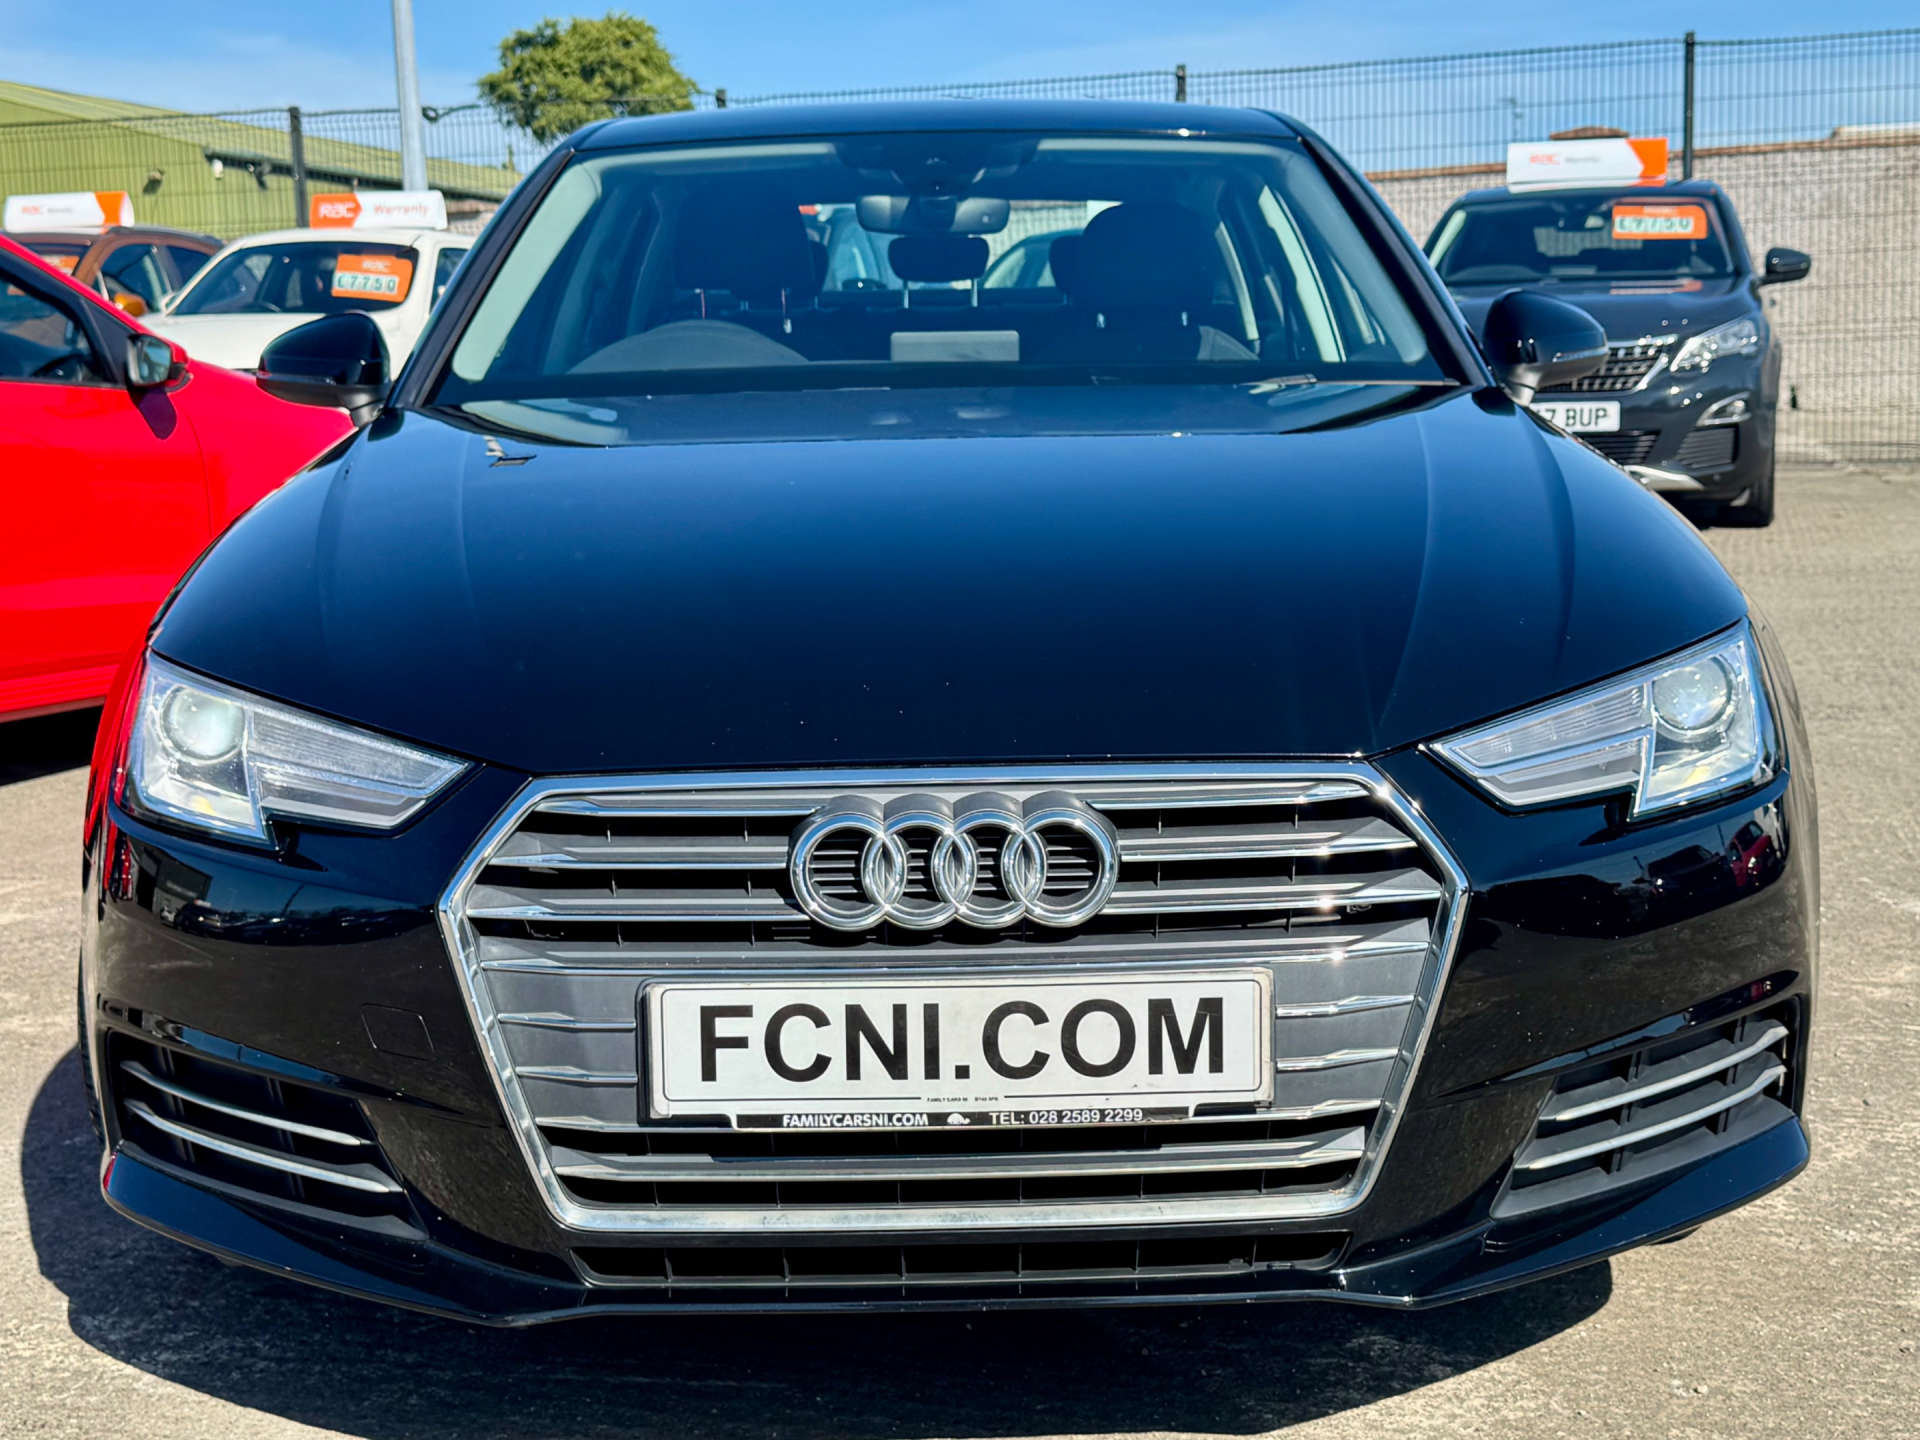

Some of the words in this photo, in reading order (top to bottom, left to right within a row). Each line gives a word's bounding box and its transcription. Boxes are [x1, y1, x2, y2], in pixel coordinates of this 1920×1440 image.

[1565, 408, 1608, 427] BUP
[700, 997, 1224, 1083] FCNI.COM
[782, 1112, 929, 1127] FAMILYCARSNI.COM
[988, 1111, 1025, 1125] TEL:
[1029, 1110, 1058, 1124] 028
[1061, 1109, 1101, 1123] 2589
[1104, 1108, 1144, 1122] 2299
